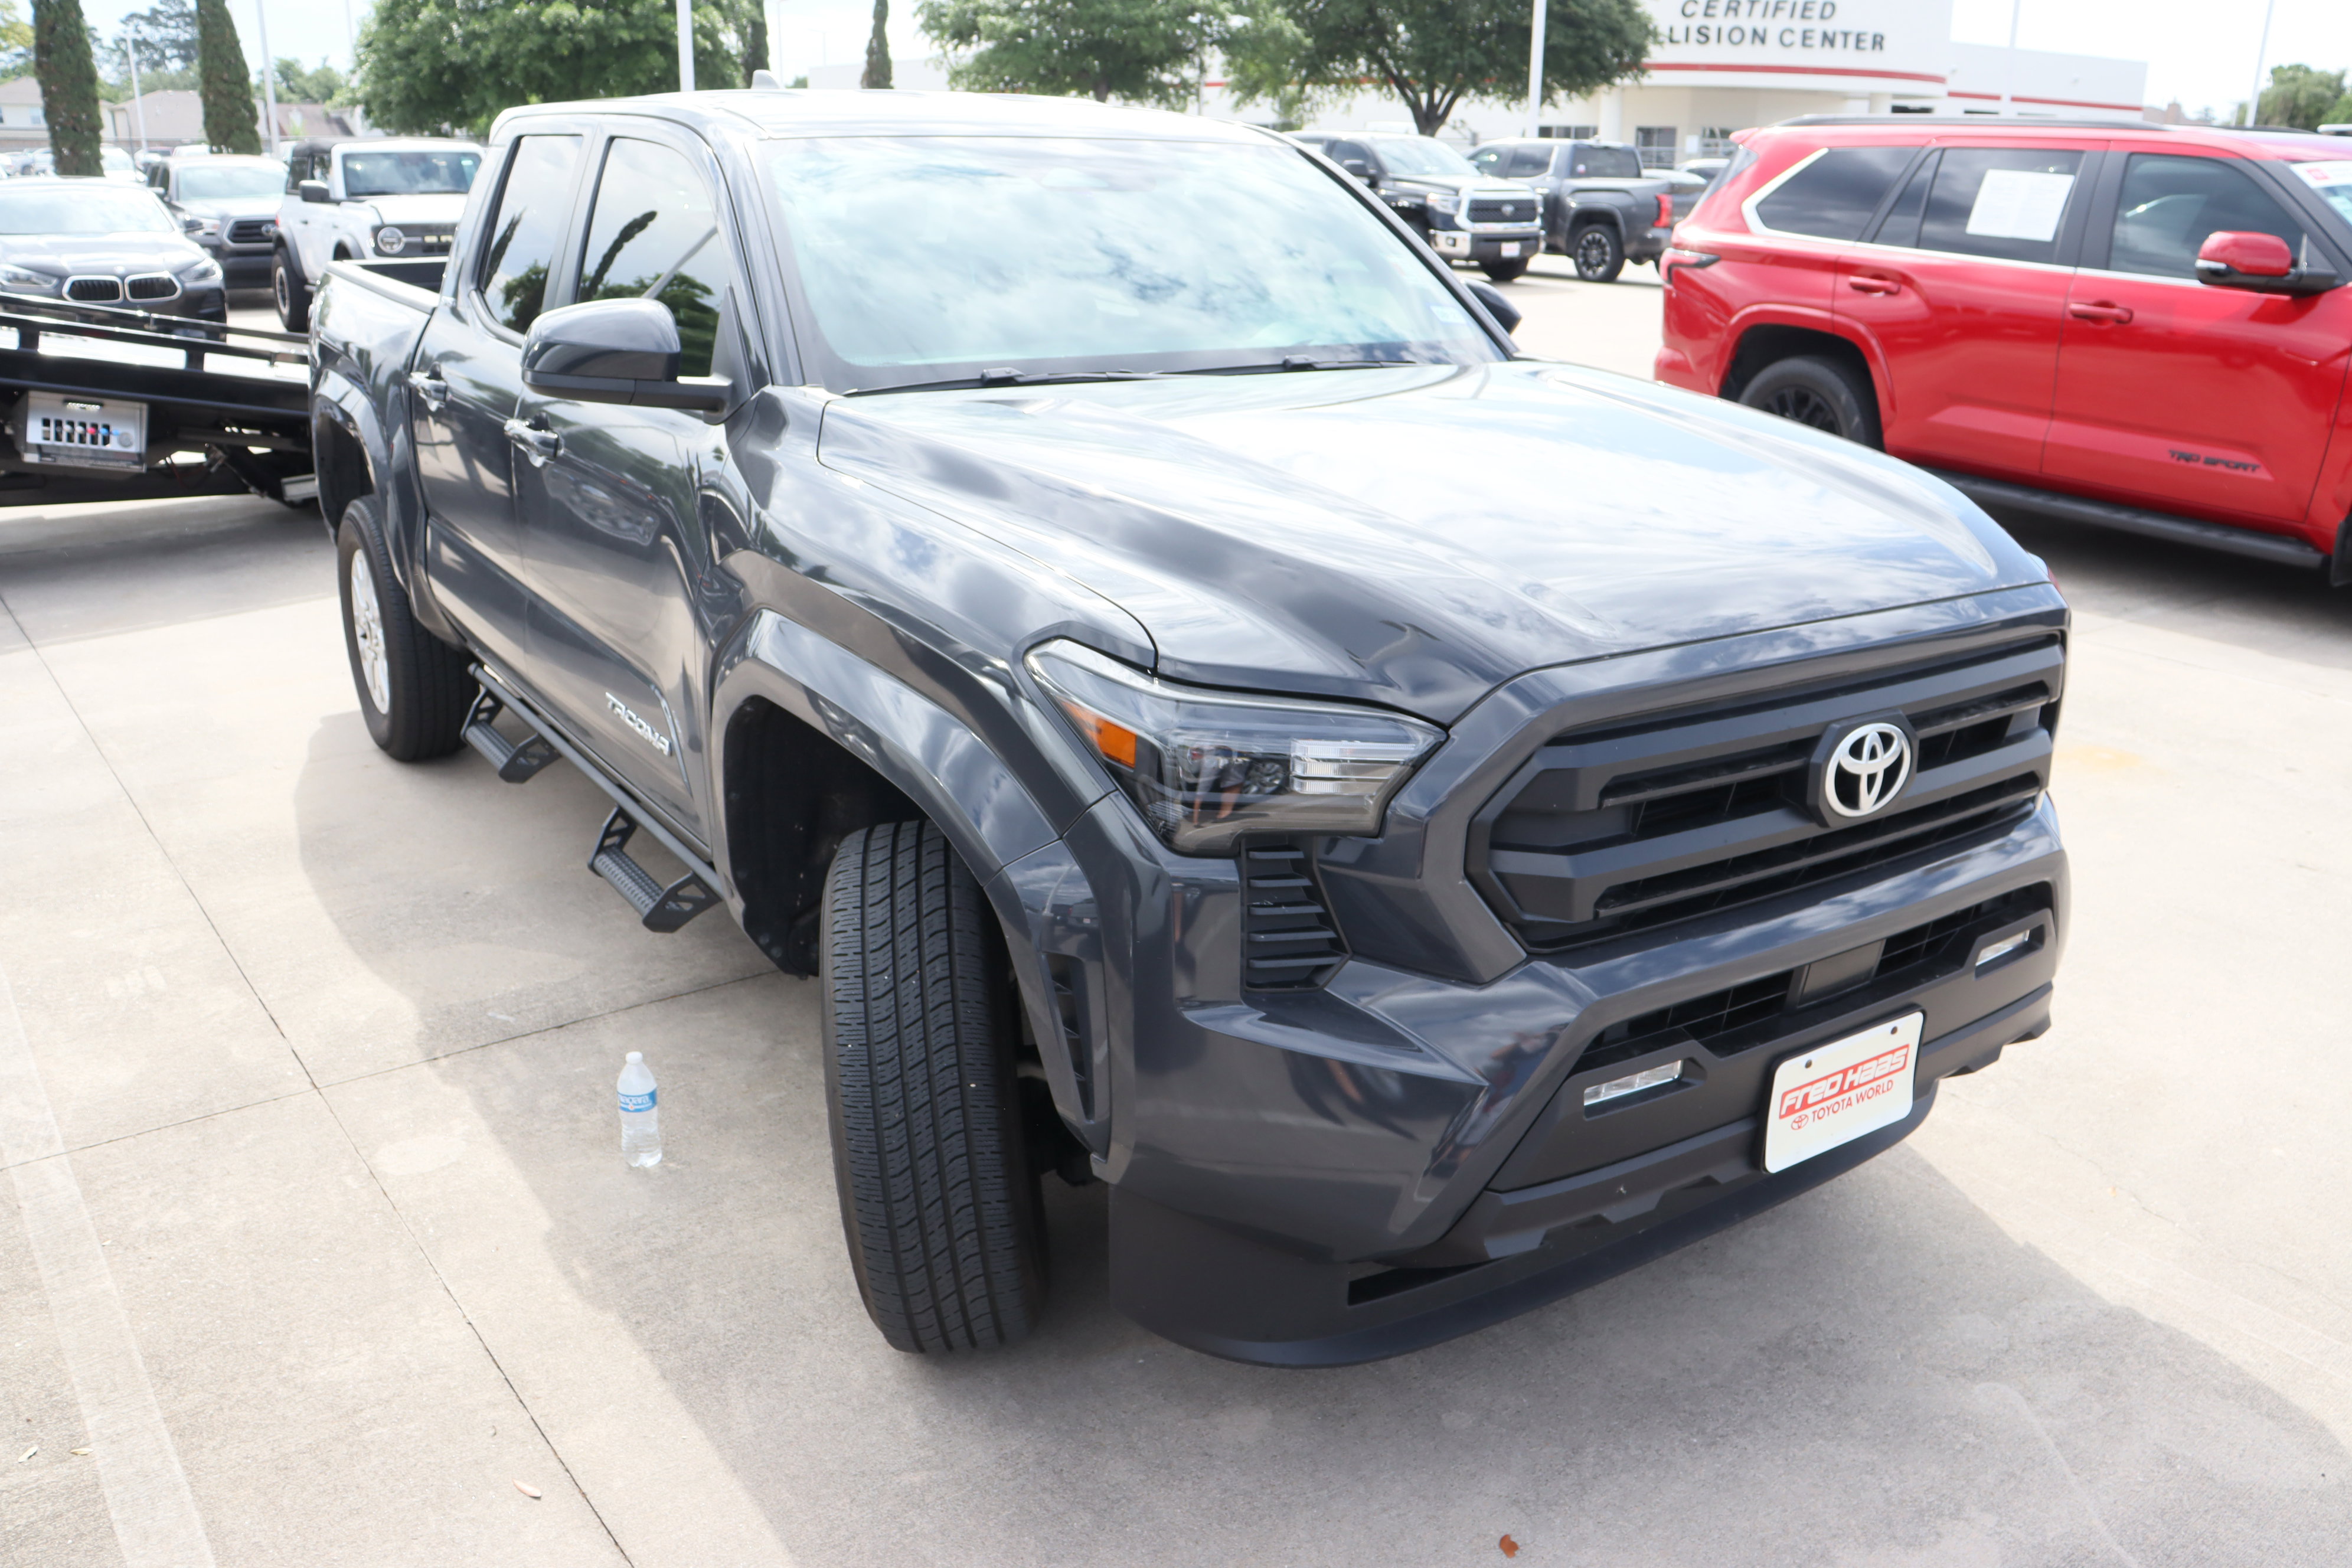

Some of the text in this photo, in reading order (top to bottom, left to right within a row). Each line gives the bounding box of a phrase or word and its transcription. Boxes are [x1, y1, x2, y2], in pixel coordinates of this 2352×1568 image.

[1681, 0, 1835, 20] CERTIFIED
[1779, 27, 1885, 51] CENTER
[2168, 449, 2262, 472] TRD SPORT
[605, 691, 671, 756] TACOMA
[1812, 1079, 1894, 1122] TOYOTA WORLD
